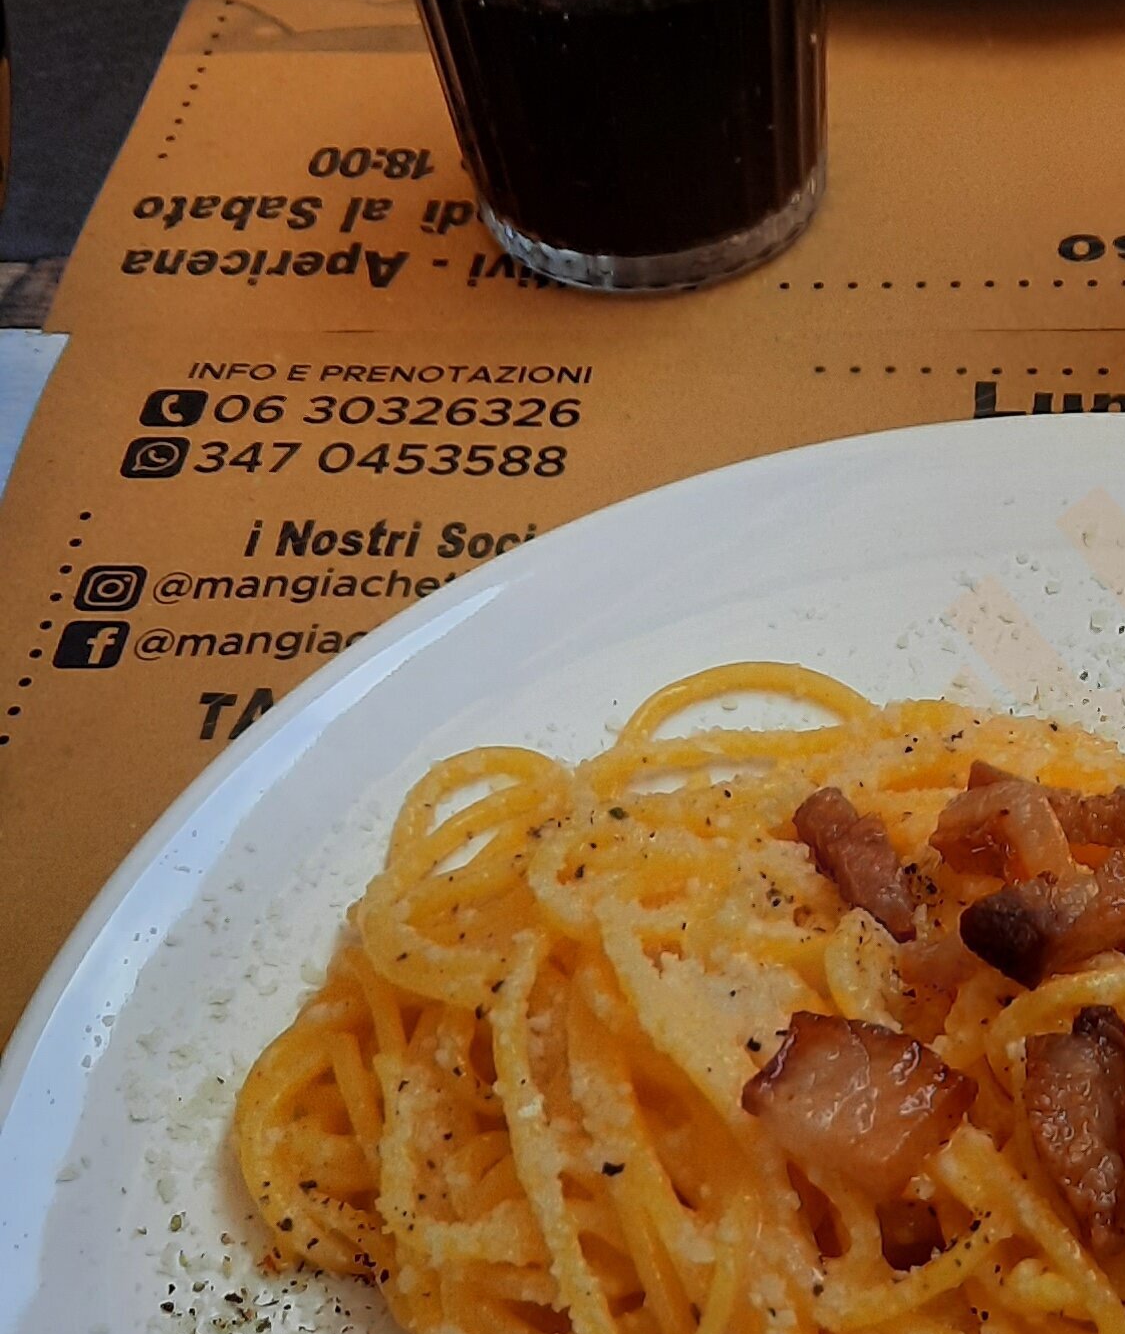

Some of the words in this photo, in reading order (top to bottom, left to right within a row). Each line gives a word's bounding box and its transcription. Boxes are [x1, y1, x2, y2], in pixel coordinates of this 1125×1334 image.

[307, 145, 437, 179] 18:00
[132, 195, 323, 230] Sabato
[339, 199, 393, 234] al
[120, 249, 411, 289] Apericena
[188, 362, 276, 382] INFO
[286, 364, 306, 383] E
[319, 363, 593, 385] PRENOTAZIONI
[212, 394, 286, 424] 06
[302, 396, 582, 428] 30326326
[193, 441, 303, 474] 347
[317, 444, 568, 477] 0453588
[244, 519, 264, 557] i
[275, 518, 423, 558] Nostri
